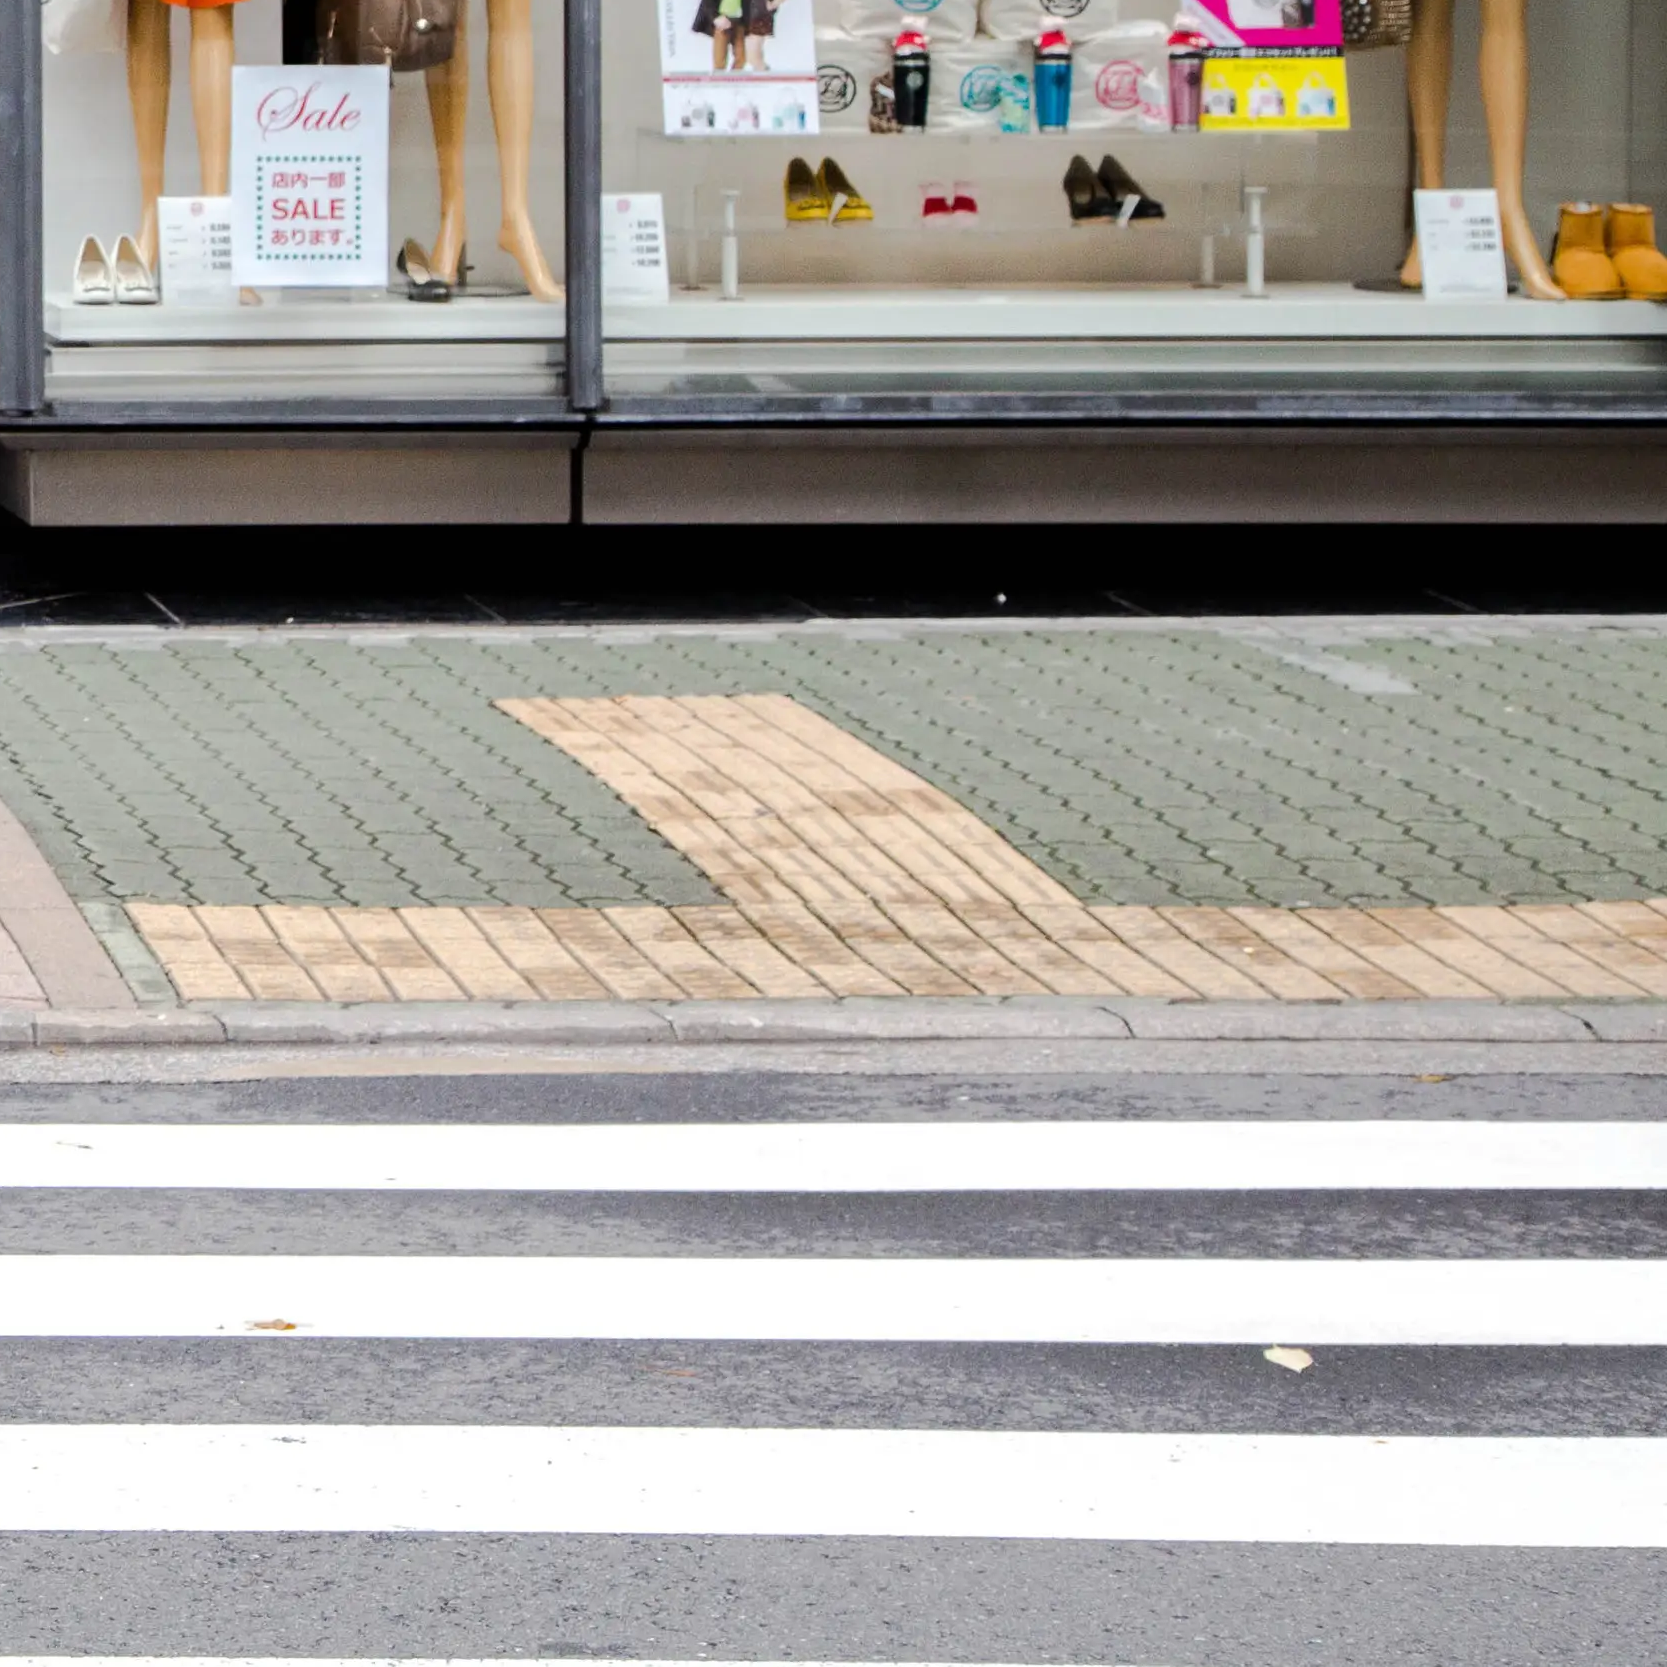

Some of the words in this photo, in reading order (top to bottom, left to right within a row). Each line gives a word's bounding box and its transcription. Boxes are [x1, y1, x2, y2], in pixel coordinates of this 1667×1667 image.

[255, 82, 362, 141] Sale
[271, 171, 346, 190] 店内一部
[271, 198, 346, 221] SALE
[270, 227, 355, 247] あります。
